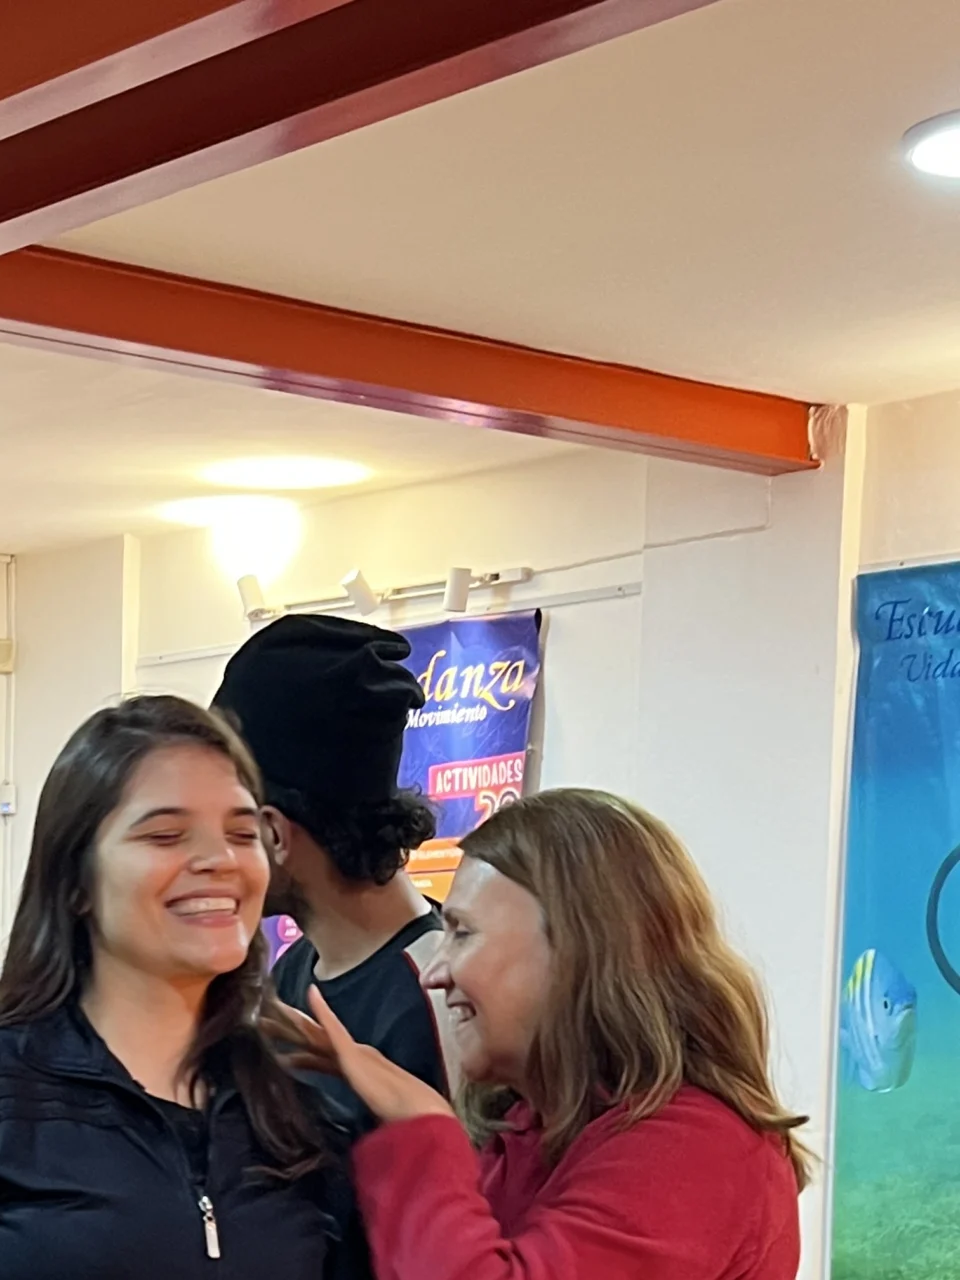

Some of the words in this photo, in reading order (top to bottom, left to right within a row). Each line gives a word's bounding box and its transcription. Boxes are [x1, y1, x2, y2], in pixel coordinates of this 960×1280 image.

[874, 598, 960, 641] Escu
[405, 702, 488, 730] Movimiento
[435, 759, 523, 793] ACTIVIDADES
